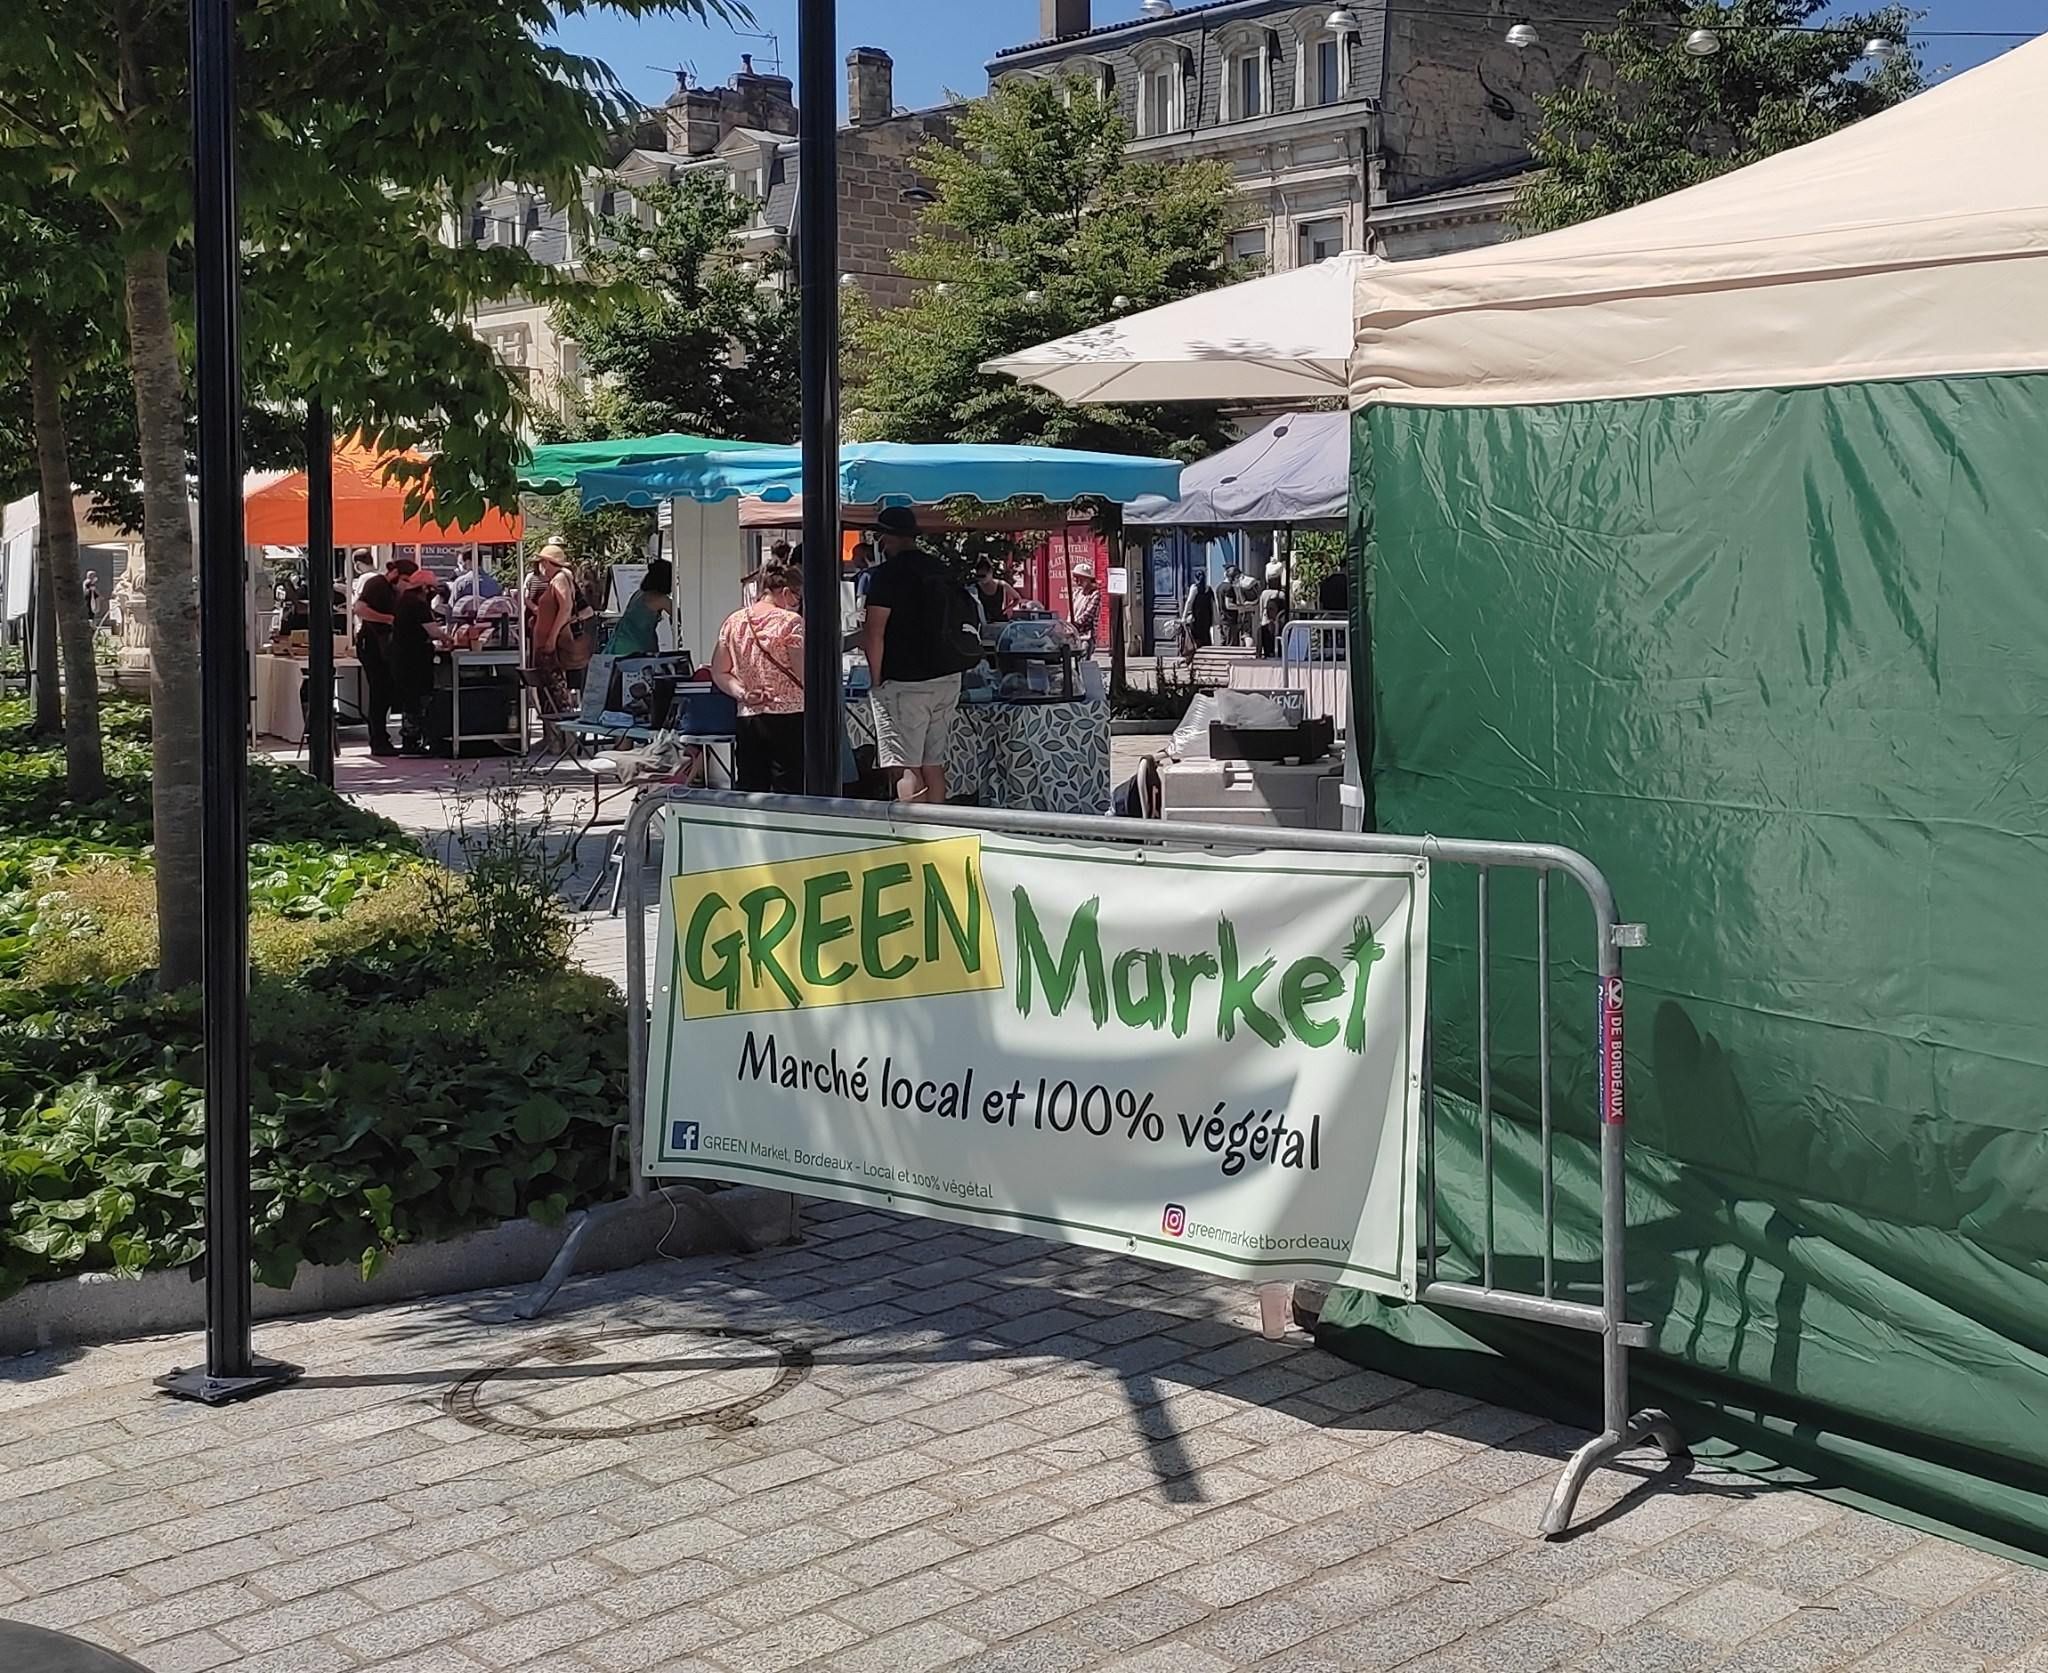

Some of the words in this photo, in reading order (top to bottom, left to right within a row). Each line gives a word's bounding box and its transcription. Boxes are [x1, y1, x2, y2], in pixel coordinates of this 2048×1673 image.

[685, 856, 981, 1010] GREEN
[1012, 884, 1385, 1055] Market
[1610, 1016, 1623, 1036] DE
[738, 1031, 869, 1102] Marché
[881, 1057, 973, 1120] local
[982, 1079, 1026, 1127] et
[1034, 1077, 1164, 1142] 100%
[1177, 1101, 1320, 1176] végétal
[1610, 1041, 1624, 1117] BORDEAUX
[703, 1135, 747, 1154] GREEN
[794, 1150, 853, 1171] Bordeaux
[863, 1161, 895, 1181] Local
[897, 1170, 910, 1184] et
[912, 1174, 940, 1191] 100%
[942, 1178, 993, 1198] végétal
[1187, 1221, 1351, 1252] greenmarketbordeaux
